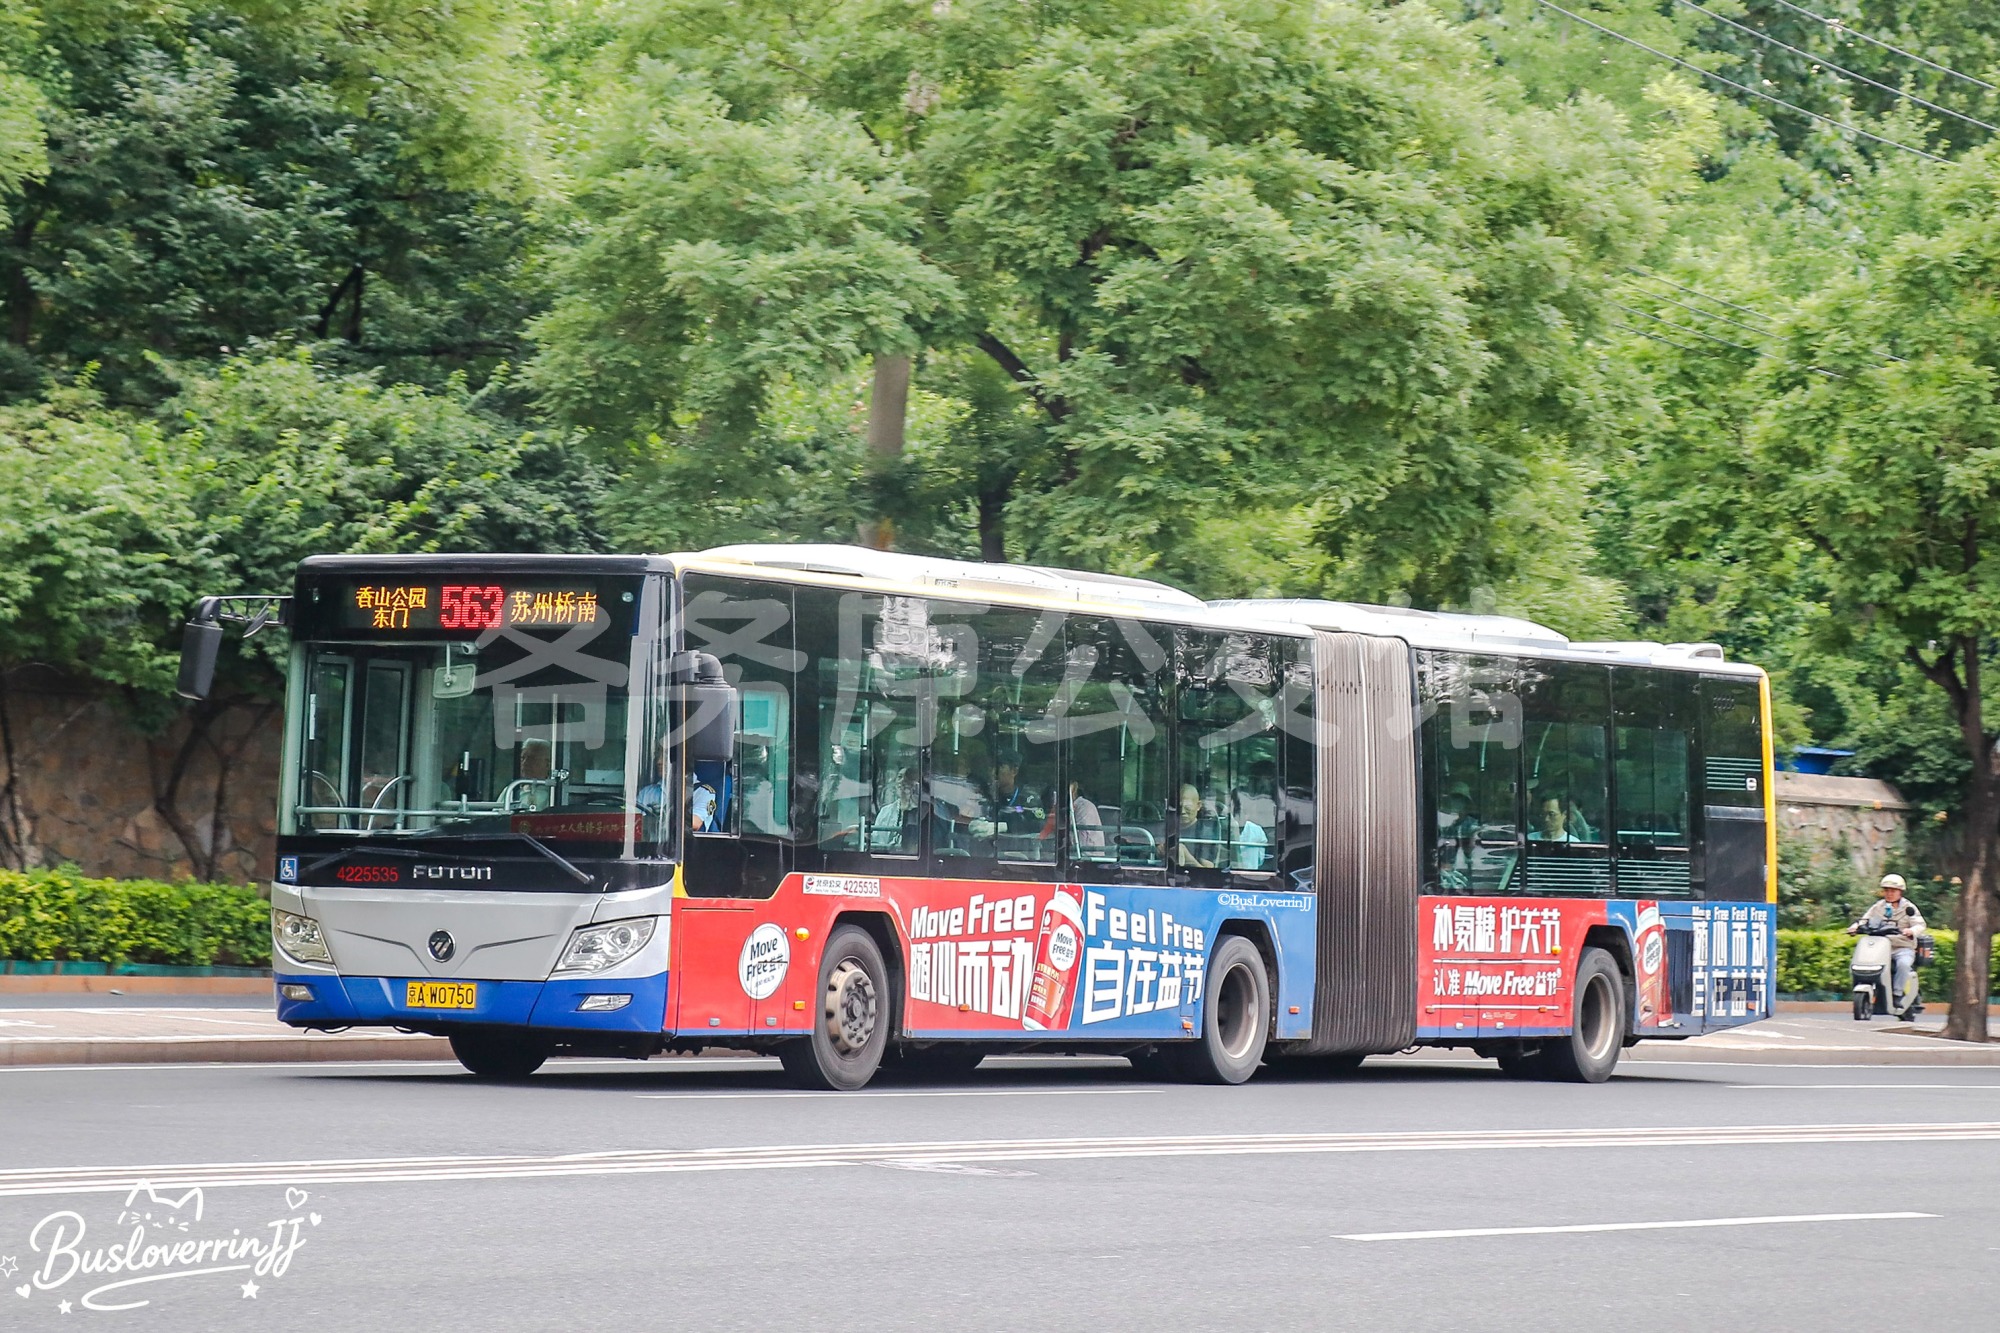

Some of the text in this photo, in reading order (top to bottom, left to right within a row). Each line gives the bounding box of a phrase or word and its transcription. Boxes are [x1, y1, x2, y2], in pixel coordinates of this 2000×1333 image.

[356, 586, 427, 609] 香山公园
[440, 586, 504, 628] 563
[510, 591, 597, 624] 苏州桥南
[372, 607, 409, 629] 东门
[337, 866, 399, 882] 4225535
[412, 865, 492, 880] FOTON
[843, 880, 879, 894] 4225535
[911, 894, 1036, 939] Move Free
[1087, 890, 1204, 950] Feel Free
[1751, 906, 1767, 921] Free
[1433, 904, 1561, 954] 补氨糖 护关节
[750, 938, 778, 961] Move
[910, 937, 1034, 1020] 随心而动
[1082, 940, 1205, 1025] 自在益节
[1433, 968, 1461, 997] 认准
[1463, 970, 1503, 996] Move
[1502, 970, 1535, 996] Free
